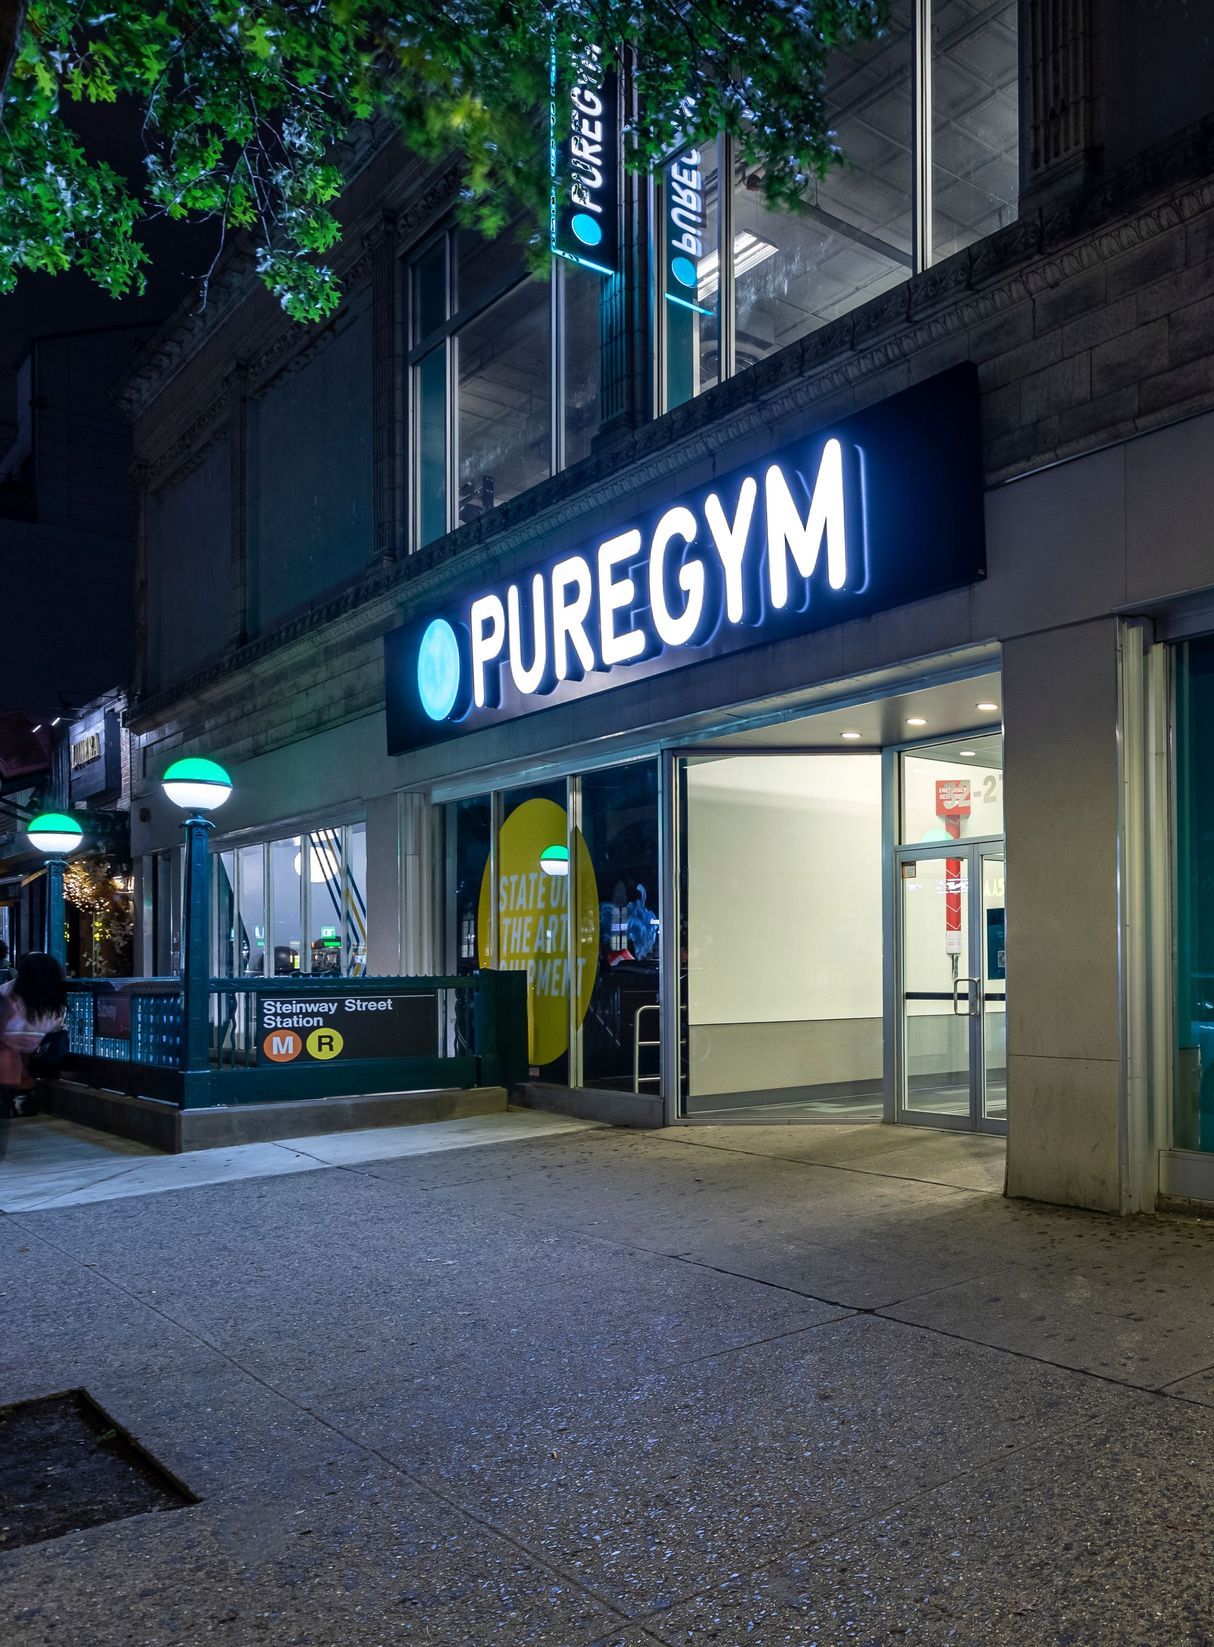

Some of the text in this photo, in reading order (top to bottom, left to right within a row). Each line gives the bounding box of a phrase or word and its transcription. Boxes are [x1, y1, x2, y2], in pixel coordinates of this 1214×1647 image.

[571, 36, 603, 213] PUREG
[470, 438, 847, 708] PUREGYM
[499, 872, 546, 912] STATE
[502, 913, 569, 954] THE ART
[499, 957, 586, 997] PMENT
[263, 999, 393, 1014] Steinway Street
[263, 1015, 323, 1028] Station
[272, 1035, 335, 1055] M R
